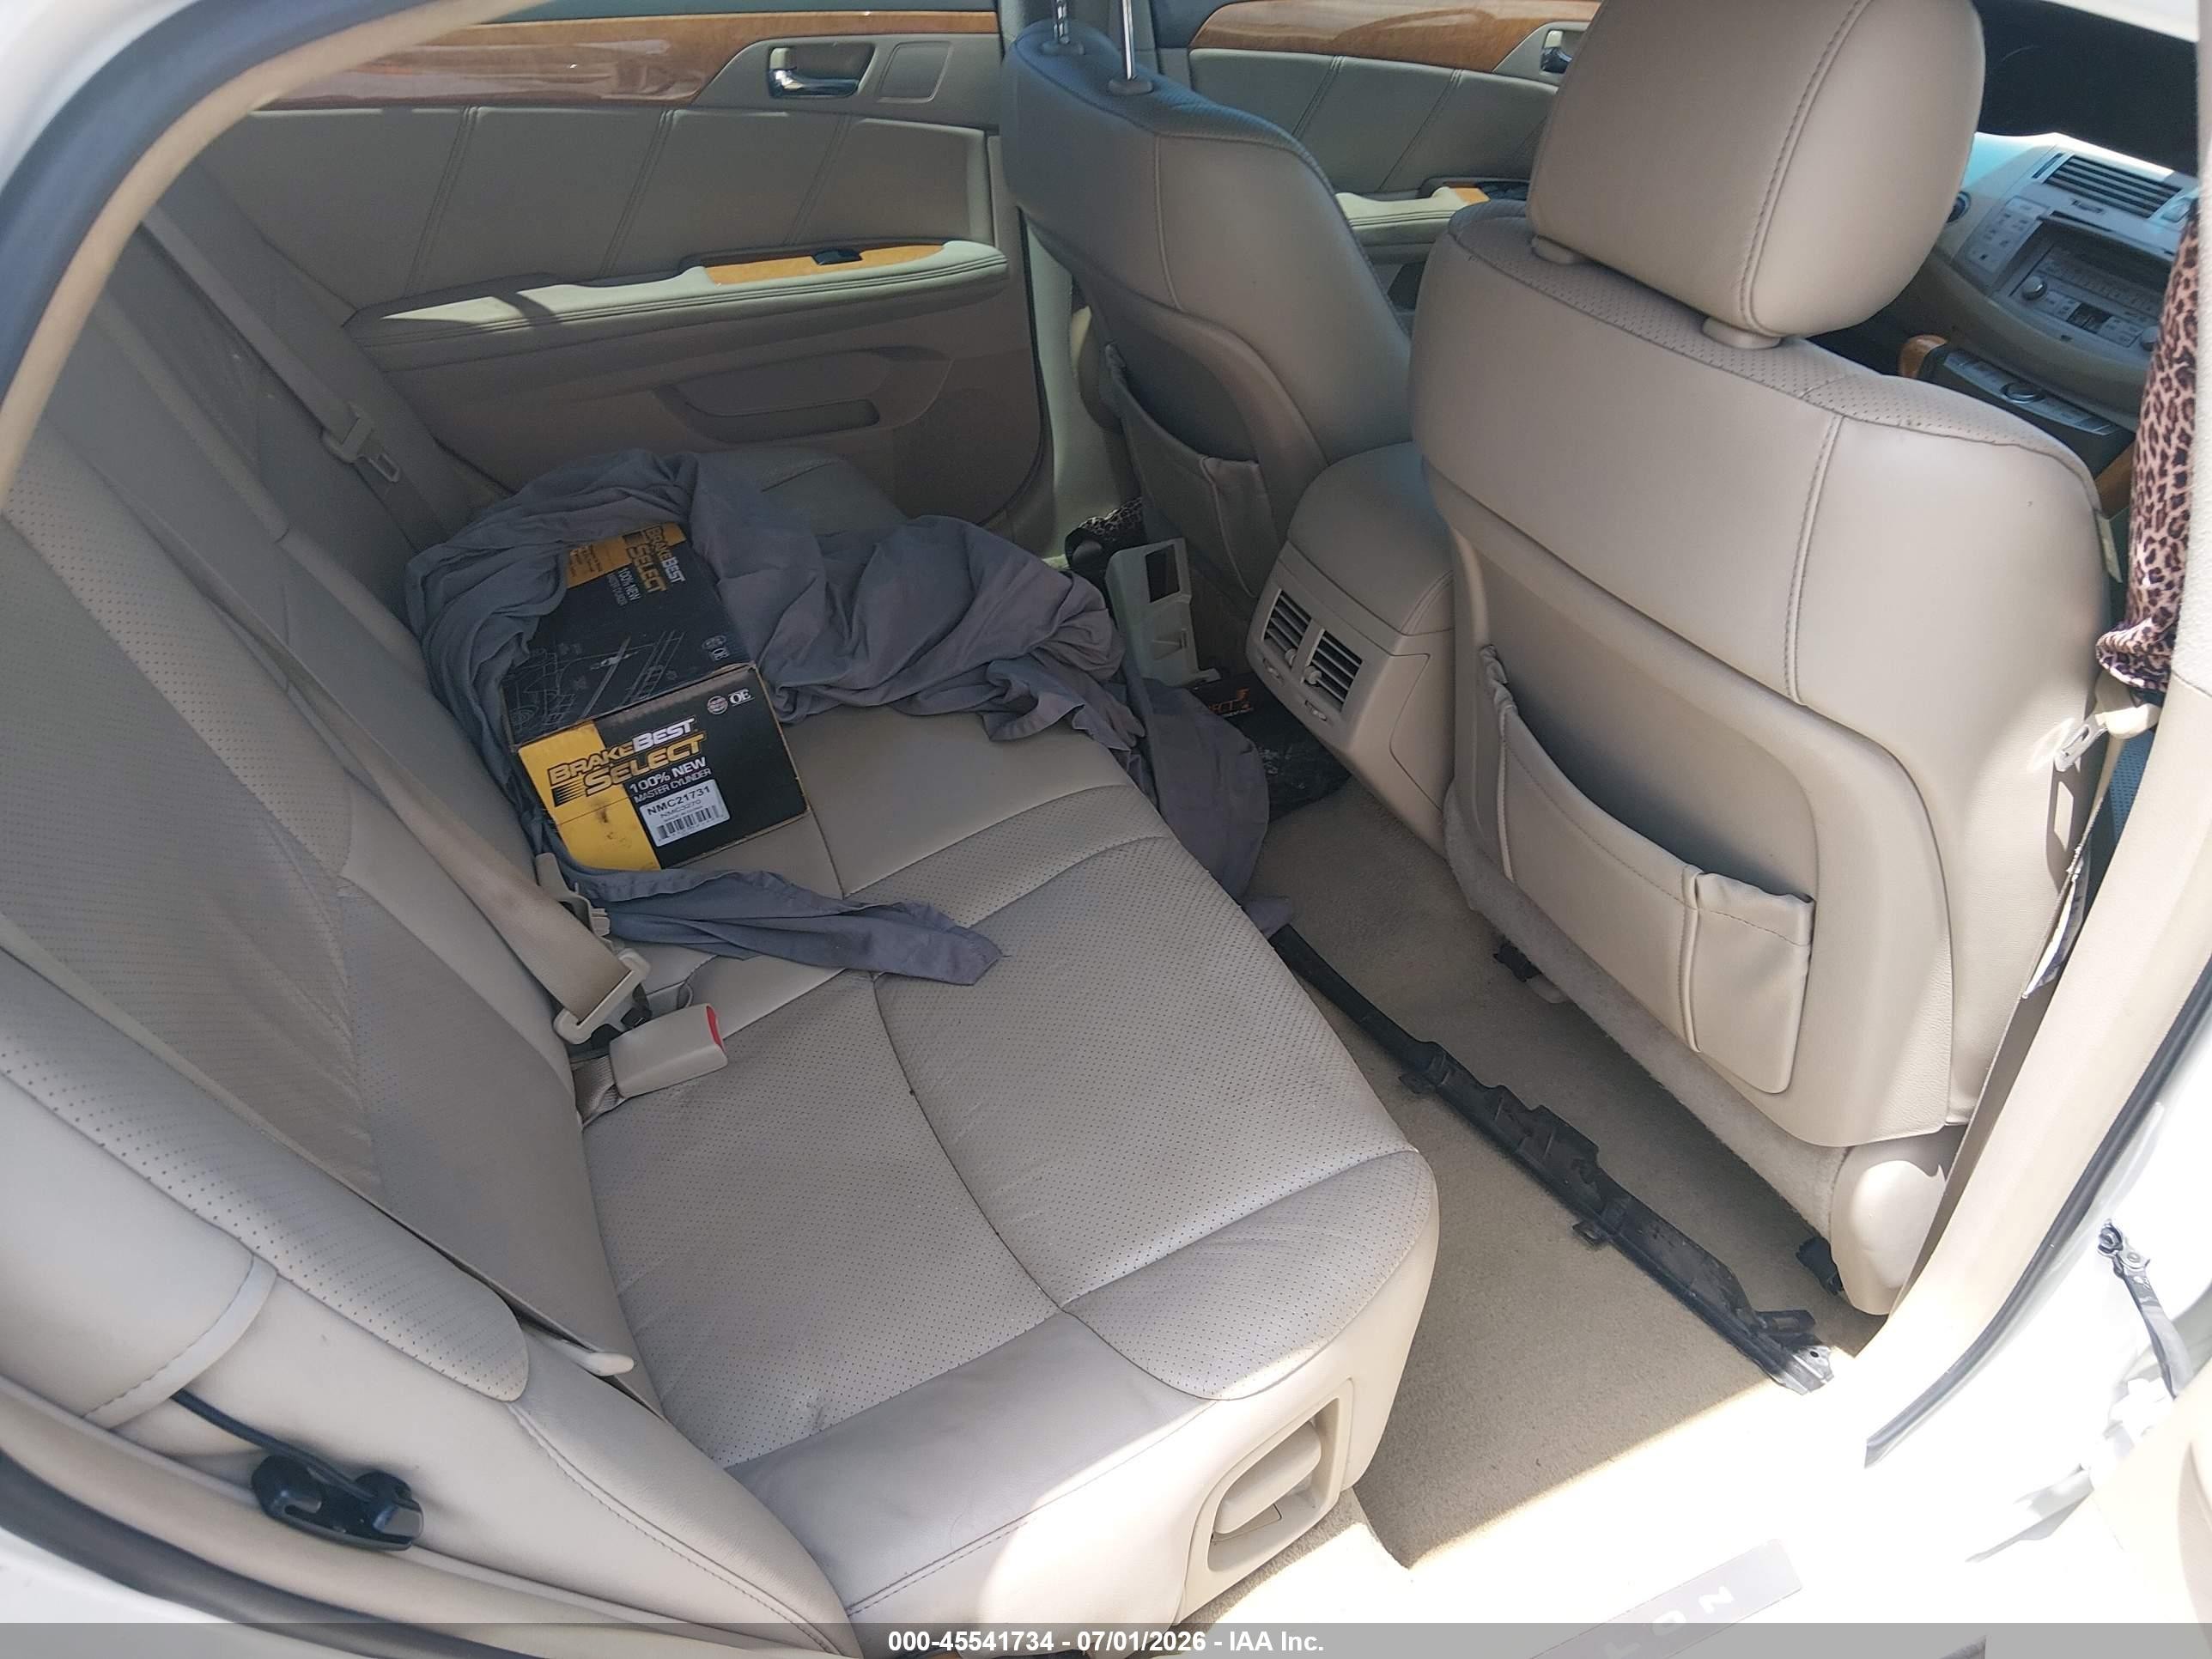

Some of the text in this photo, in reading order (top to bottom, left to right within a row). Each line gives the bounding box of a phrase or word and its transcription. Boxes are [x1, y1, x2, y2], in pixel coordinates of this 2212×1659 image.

[584, 731, 707, 797] SELECT
[629, 757, 706, 793] 100% NEW
[633, 768, 712, 804] MASTER CYLINDER
[647, 786, 710, 816] NMC21731
